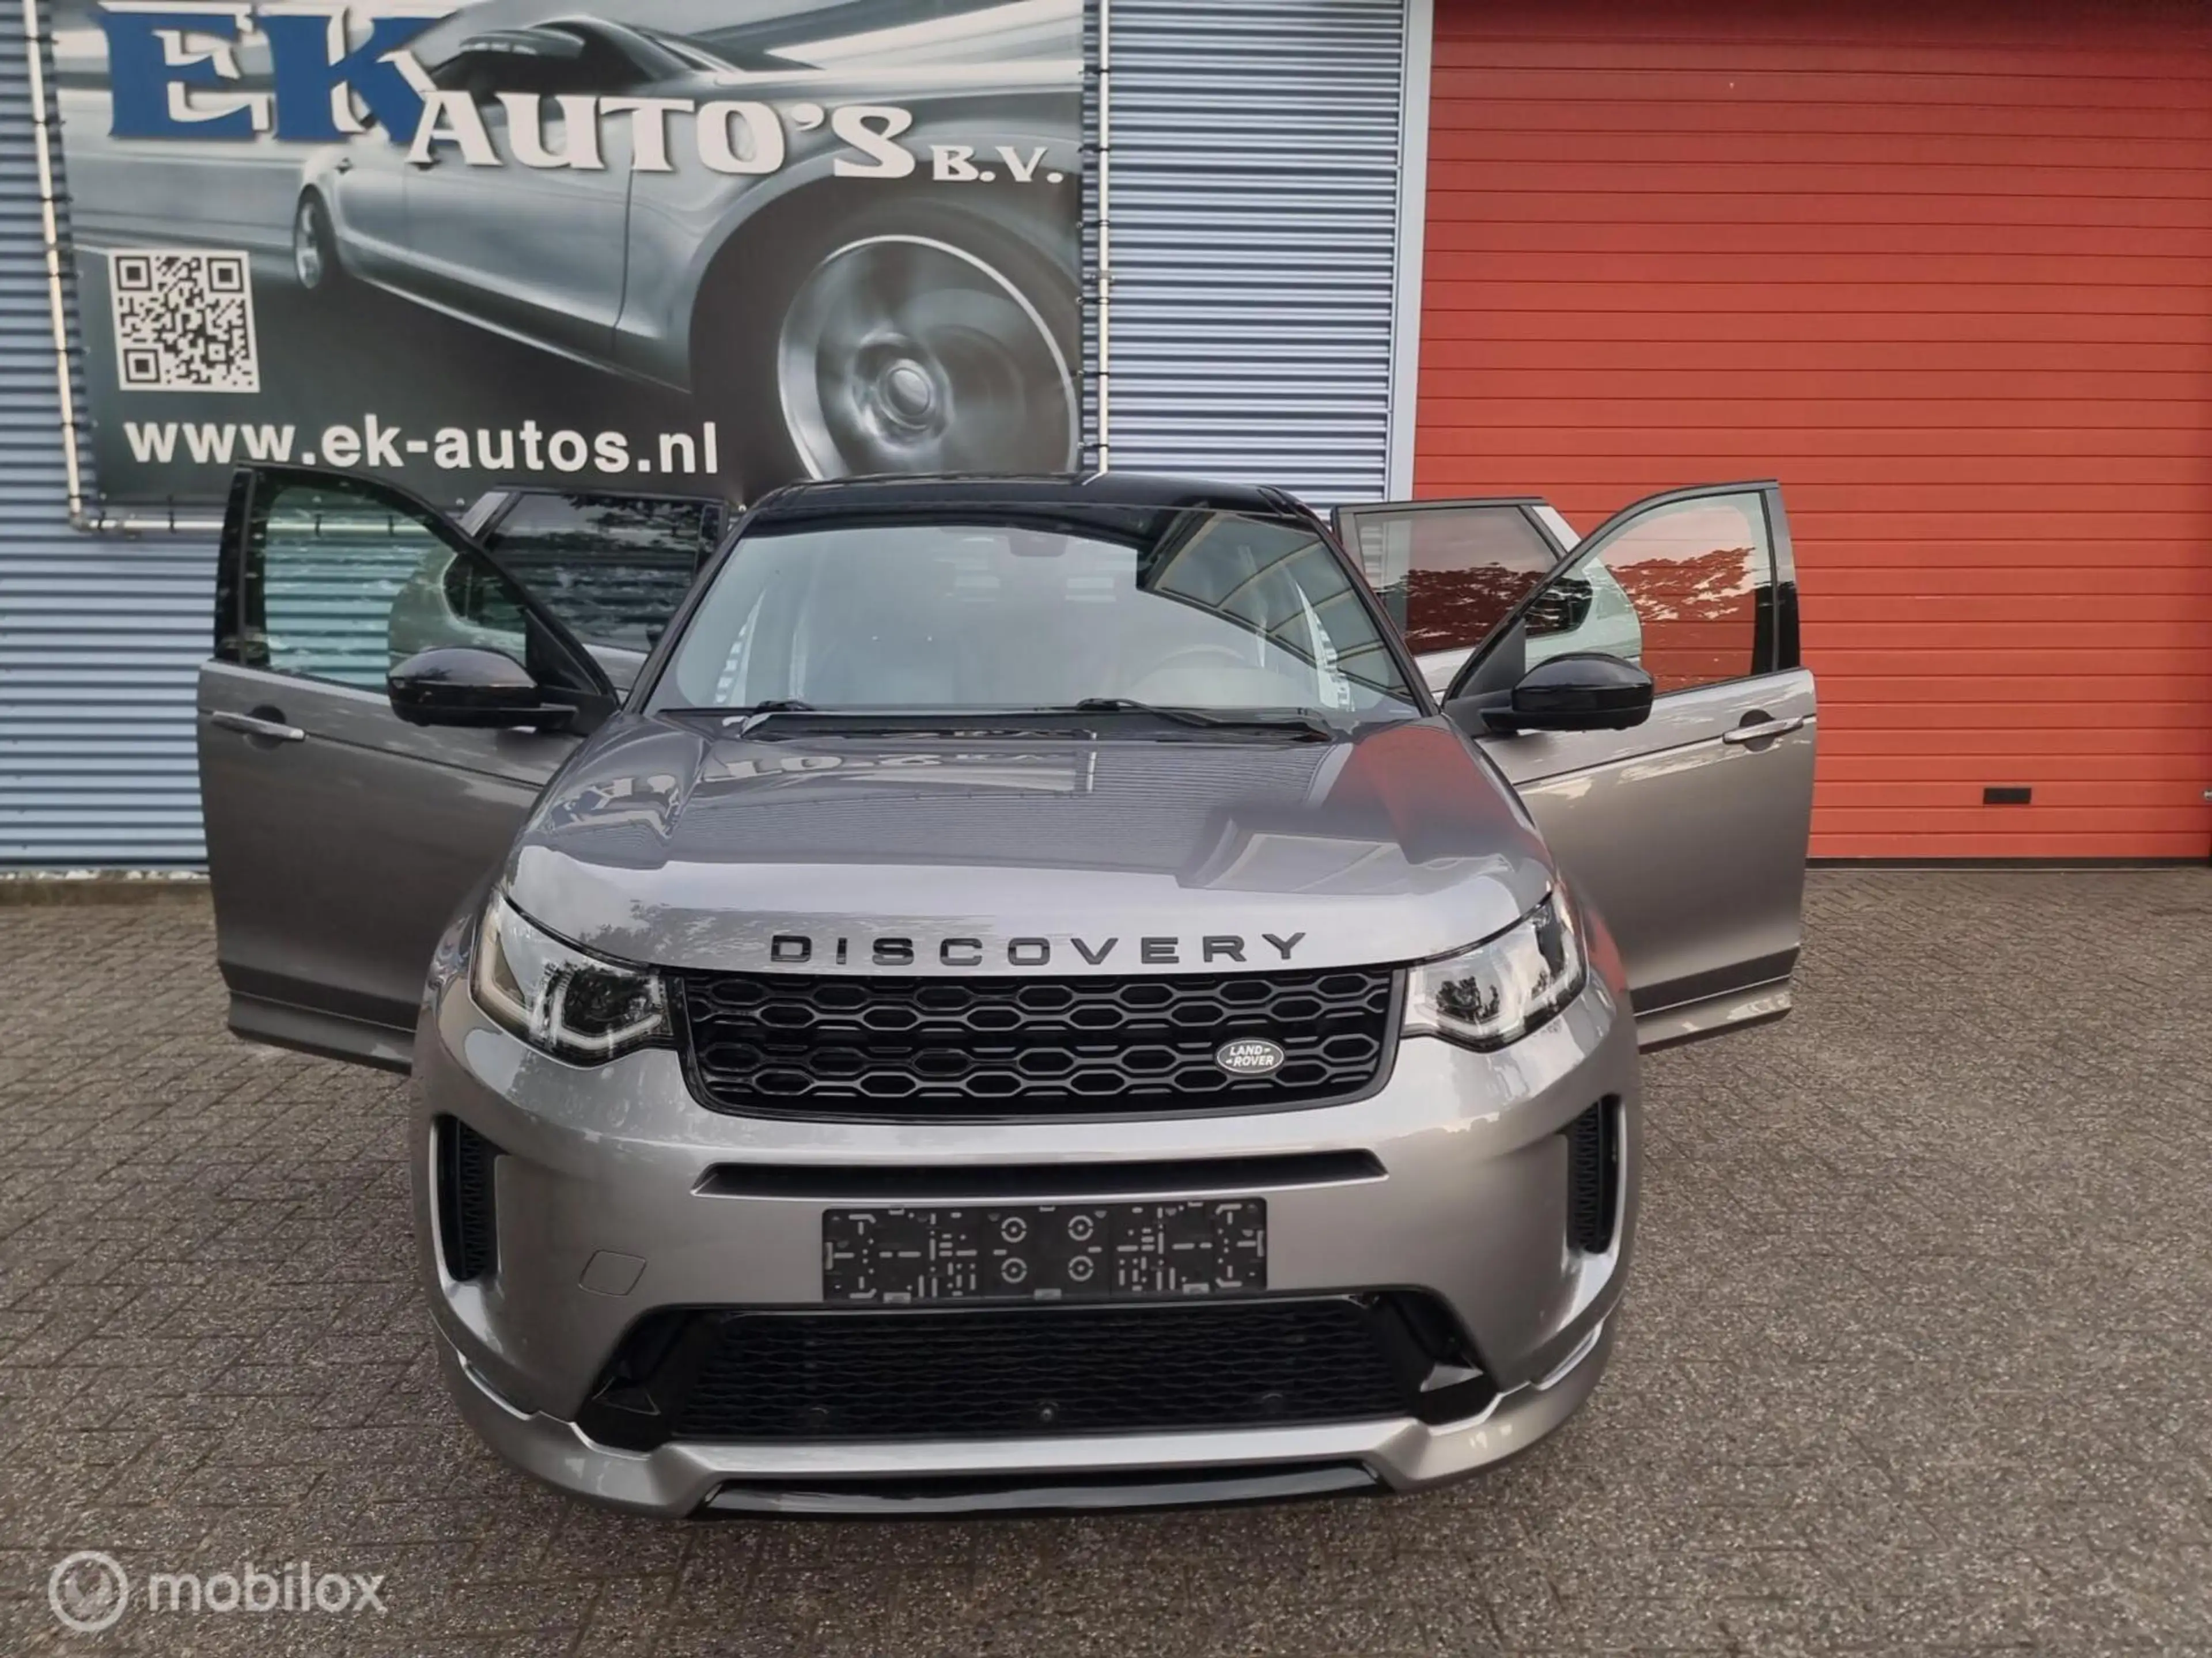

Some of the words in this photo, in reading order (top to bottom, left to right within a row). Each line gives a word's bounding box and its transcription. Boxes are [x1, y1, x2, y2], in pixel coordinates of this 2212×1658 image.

[100, 2, 462, 144] EK
[929, 144, 1065, 183] B.V.
[123, 413, 718, 474] www.ek-autos.nl
[770, 932, 1306, 966] DISCOVERY
